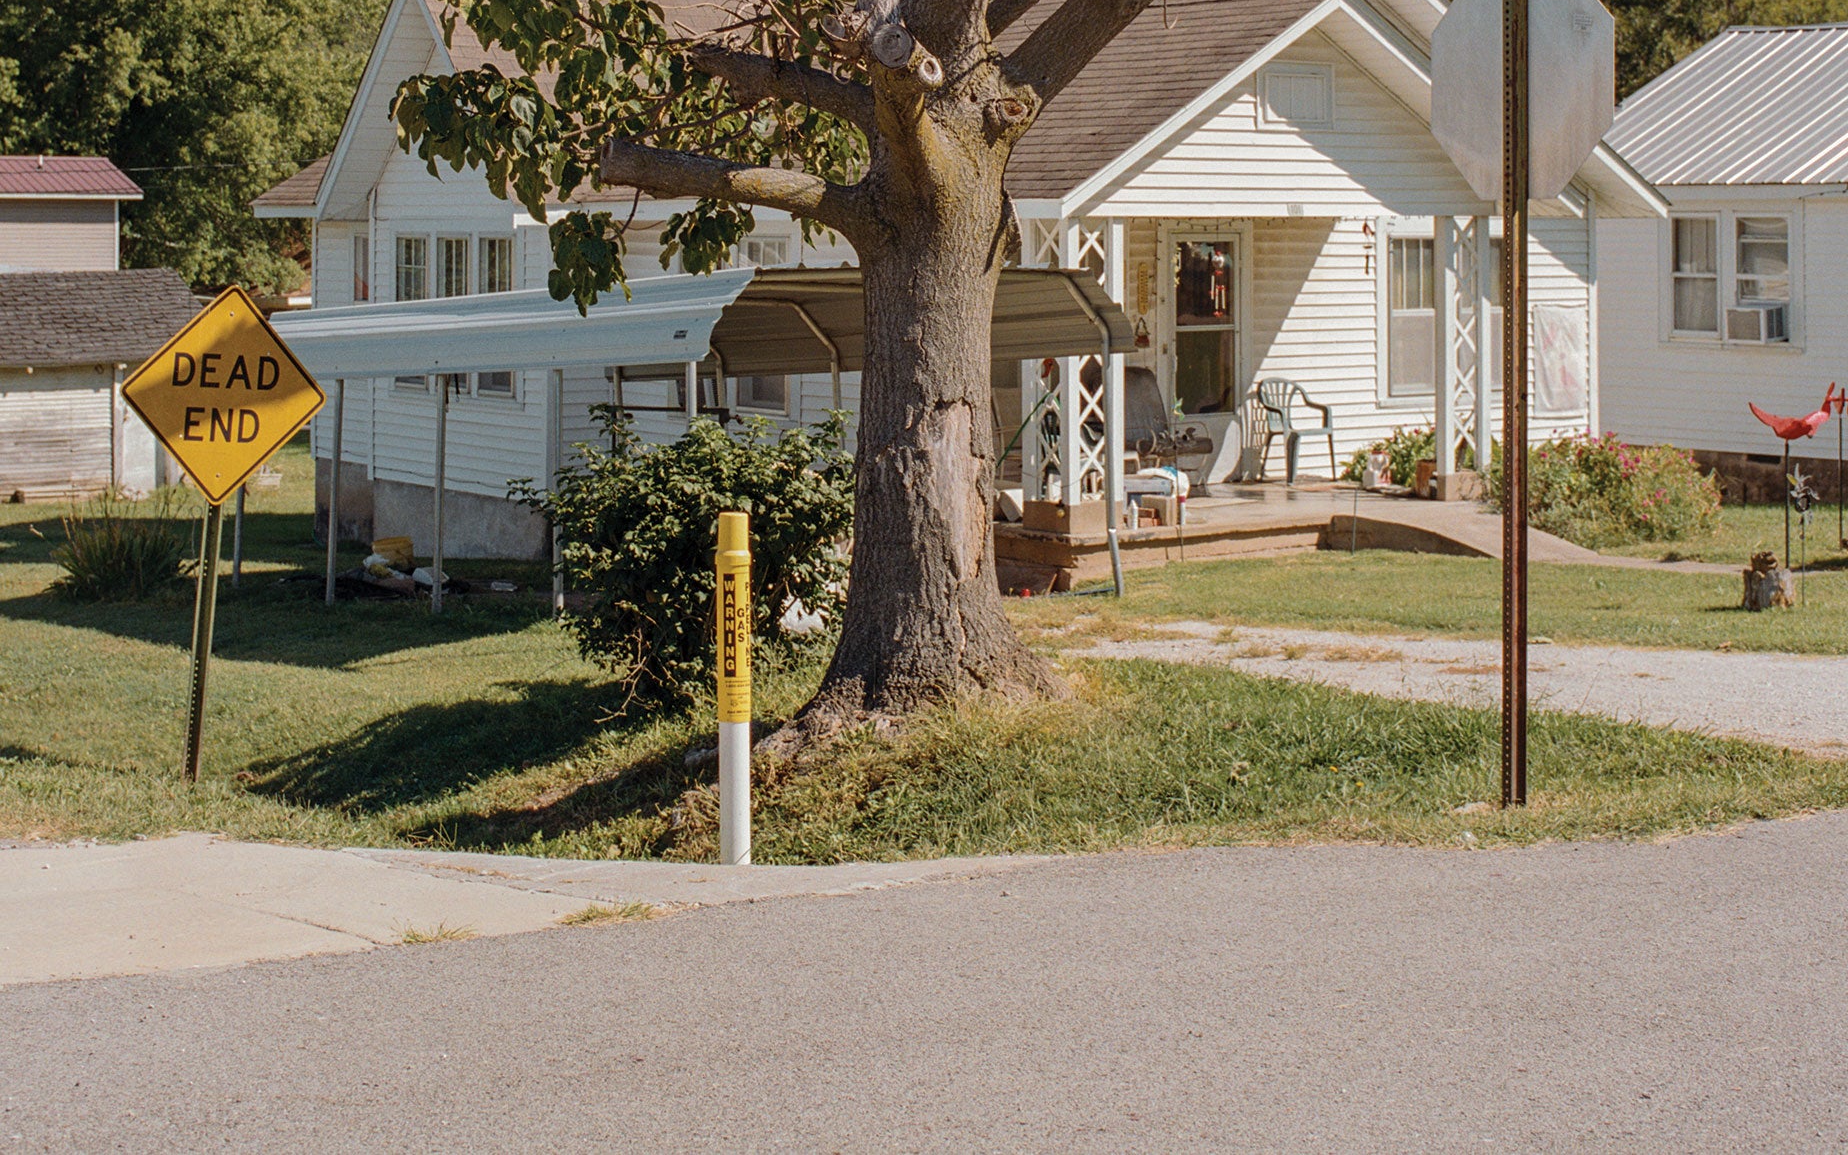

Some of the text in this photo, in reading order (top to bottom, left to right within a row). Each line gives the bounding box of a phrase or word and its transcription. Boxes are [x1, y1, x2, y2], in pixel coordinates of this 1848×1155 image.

[171, 351, 280, 391] DEAD
[183, 406, 260, 443] END
[724, 580, 735, 671] WARNING
[736, 607, 745, 643] GAS
